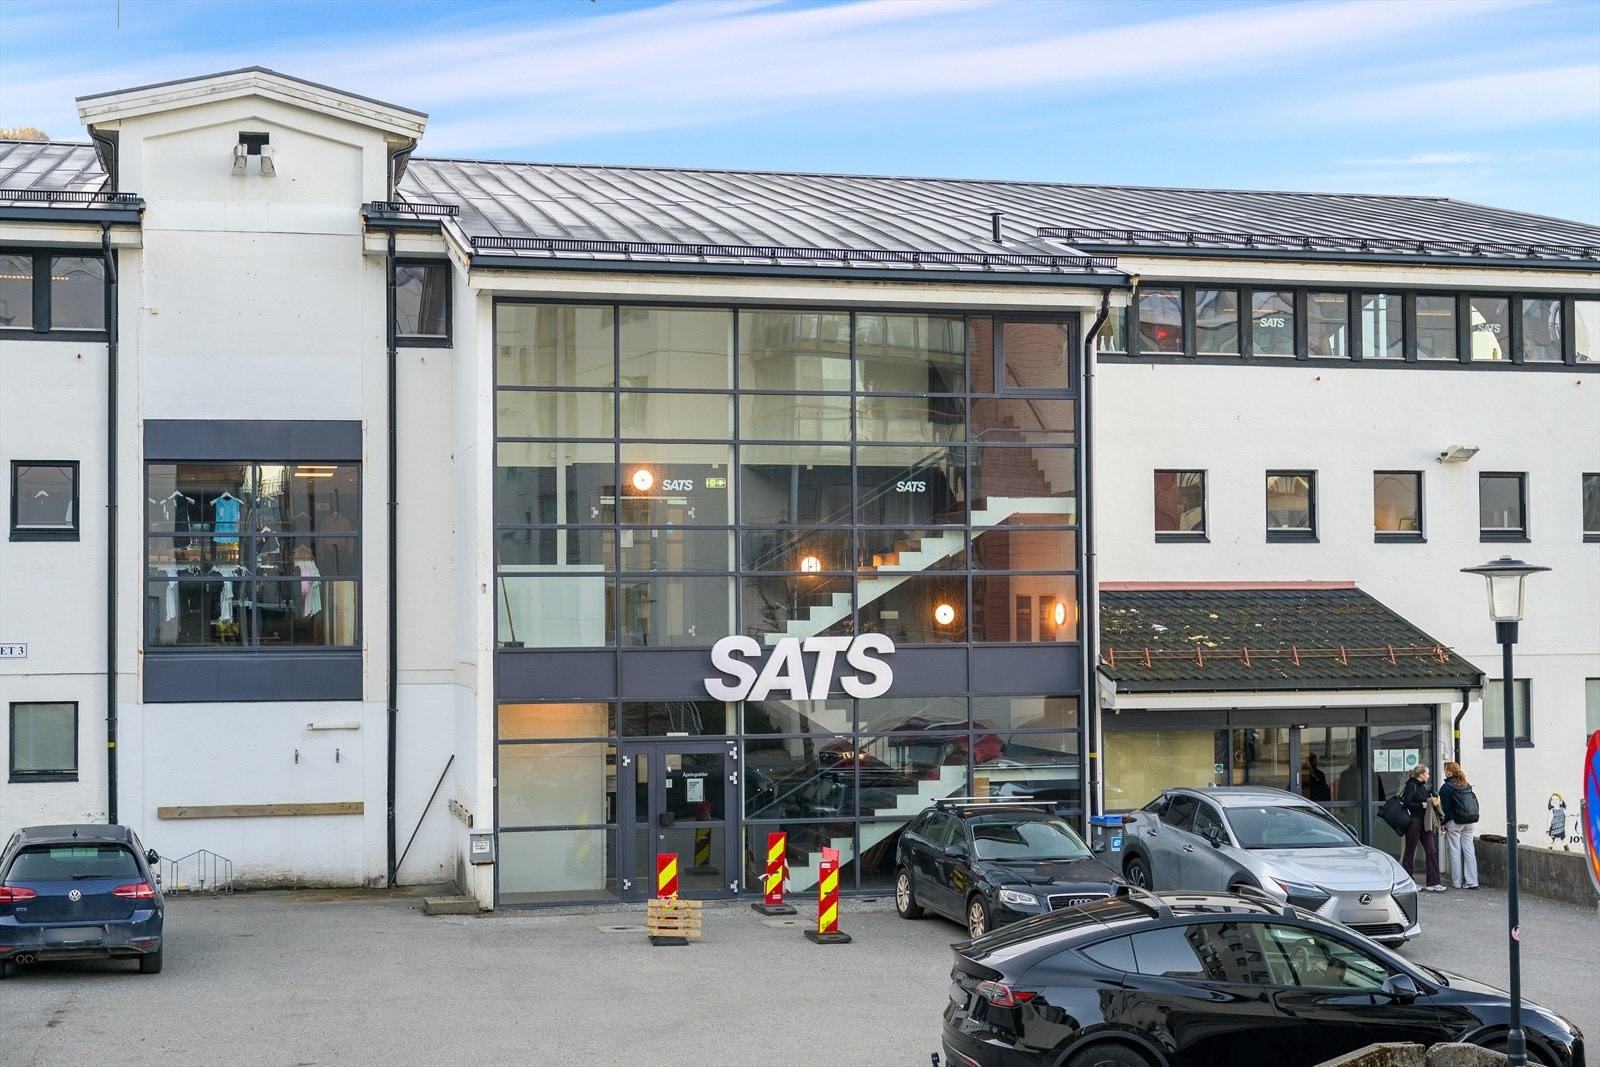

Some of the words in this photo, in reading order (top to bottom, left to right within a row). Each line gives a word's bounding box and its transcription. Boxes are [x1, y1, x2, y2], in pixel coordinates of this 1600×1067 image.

[1260, 317, 1285, 328] SATS
[1477, 323, 1501, 333] SATS
[662, 479, 694, 491] SATS
[896, 481, 926, 492] SATS
[18, 646, 24, 655] 3
[704, 633, 896, 702] SATS
